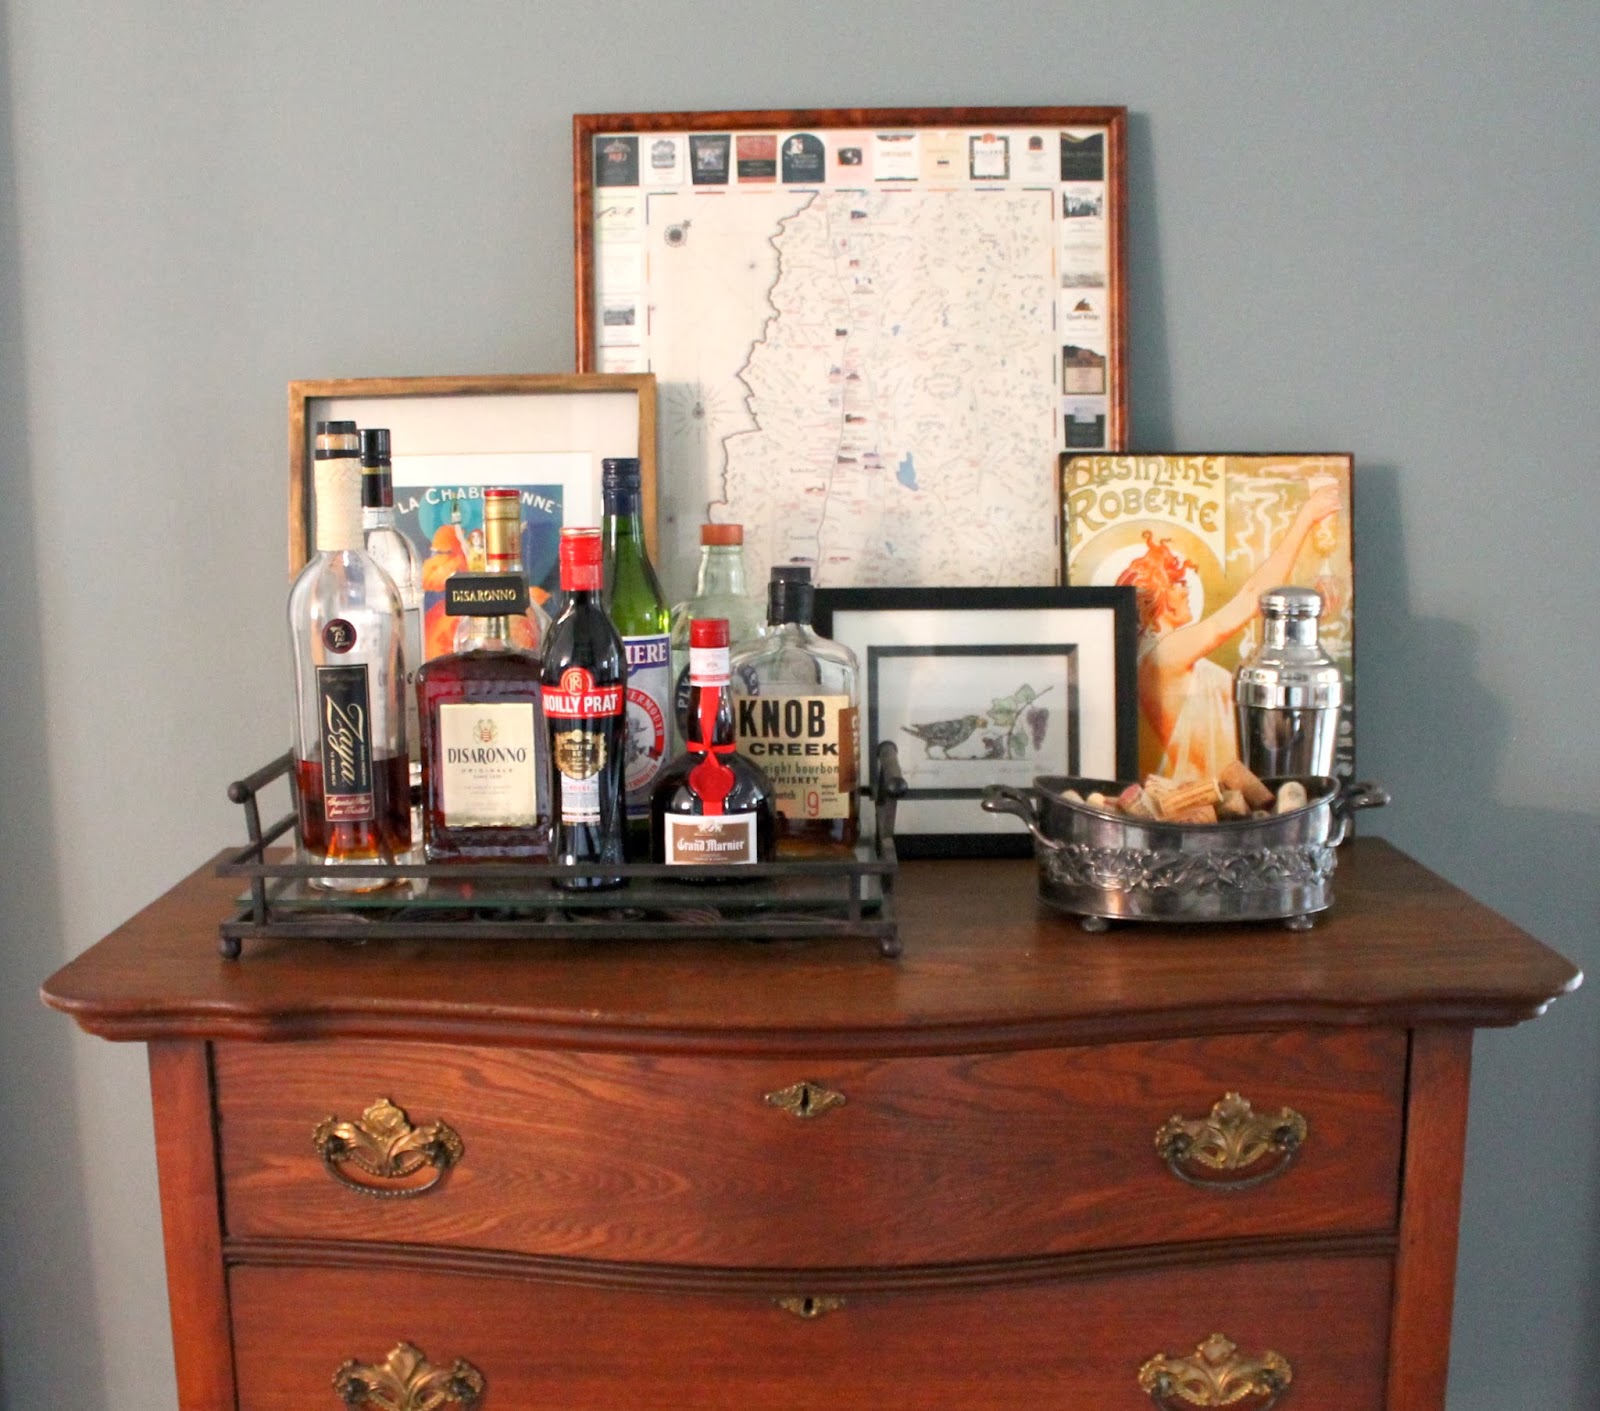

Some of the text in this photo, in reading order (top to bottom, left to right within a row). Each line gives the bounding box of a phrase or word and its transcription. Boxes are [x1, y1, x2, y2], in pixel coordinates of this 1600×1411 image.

[1066, 456, 1219, 491] ABSINTHE
[397, 487, 556, 515] LA CHABLNNE
[1069, 488, 1219, 547] ROBETTE
[452, 589, 517, 603] DISARONNO
[625, 643, 668, 664] IERE
[543, 694, 618, 713] NOILLY PRAT
[628, 690, 664, 736] ERMOUTH
[739, 700, 825, 738] KNOB
[326, 694, 365, 786] Zaya
[748, 743, 839, 756] CREEK
[448, 748, 526, 764] DISARONNO
[796, 762, 839, 774] bourbon
[807, 792, 819, 817] 9
[677, 838, 744, 852] Grand Marnier
